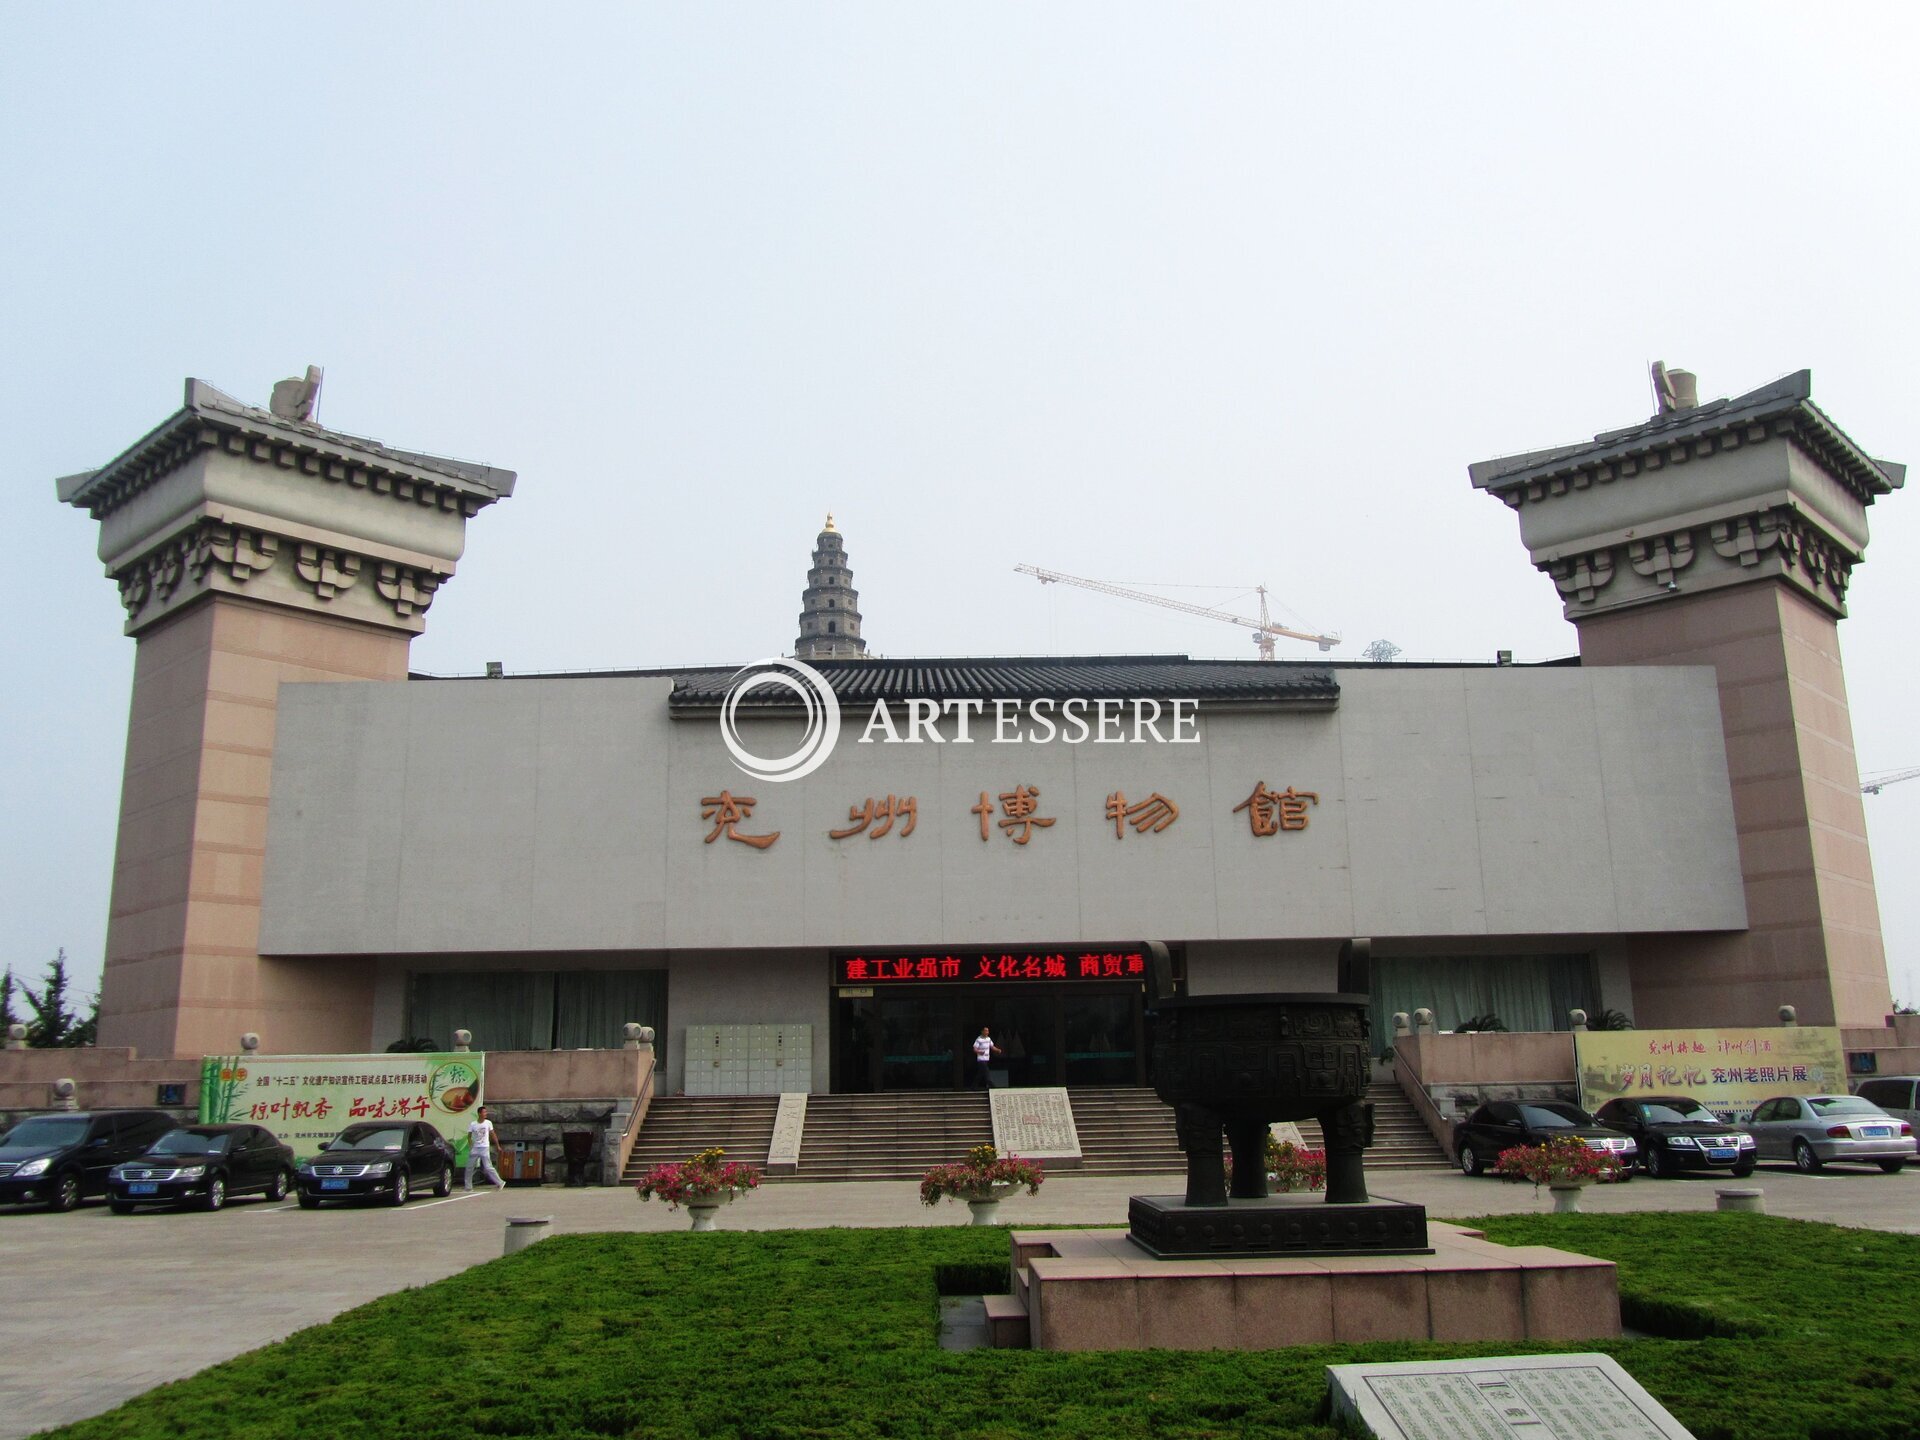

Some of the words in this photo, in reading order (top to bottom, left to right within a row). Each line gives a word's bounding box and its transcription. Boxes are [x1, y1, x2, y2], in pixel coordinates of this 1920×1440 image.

[846, 956, 960, 979] 建工业强市
[974, 954, 1067, 979] 文化名城
[1618, 1063, 1707, 1091] 岁月记忆
[1710, 1066, 1808, 1083] 兖州老照片展
[348, 1096, 431, 1119] 品味端午
